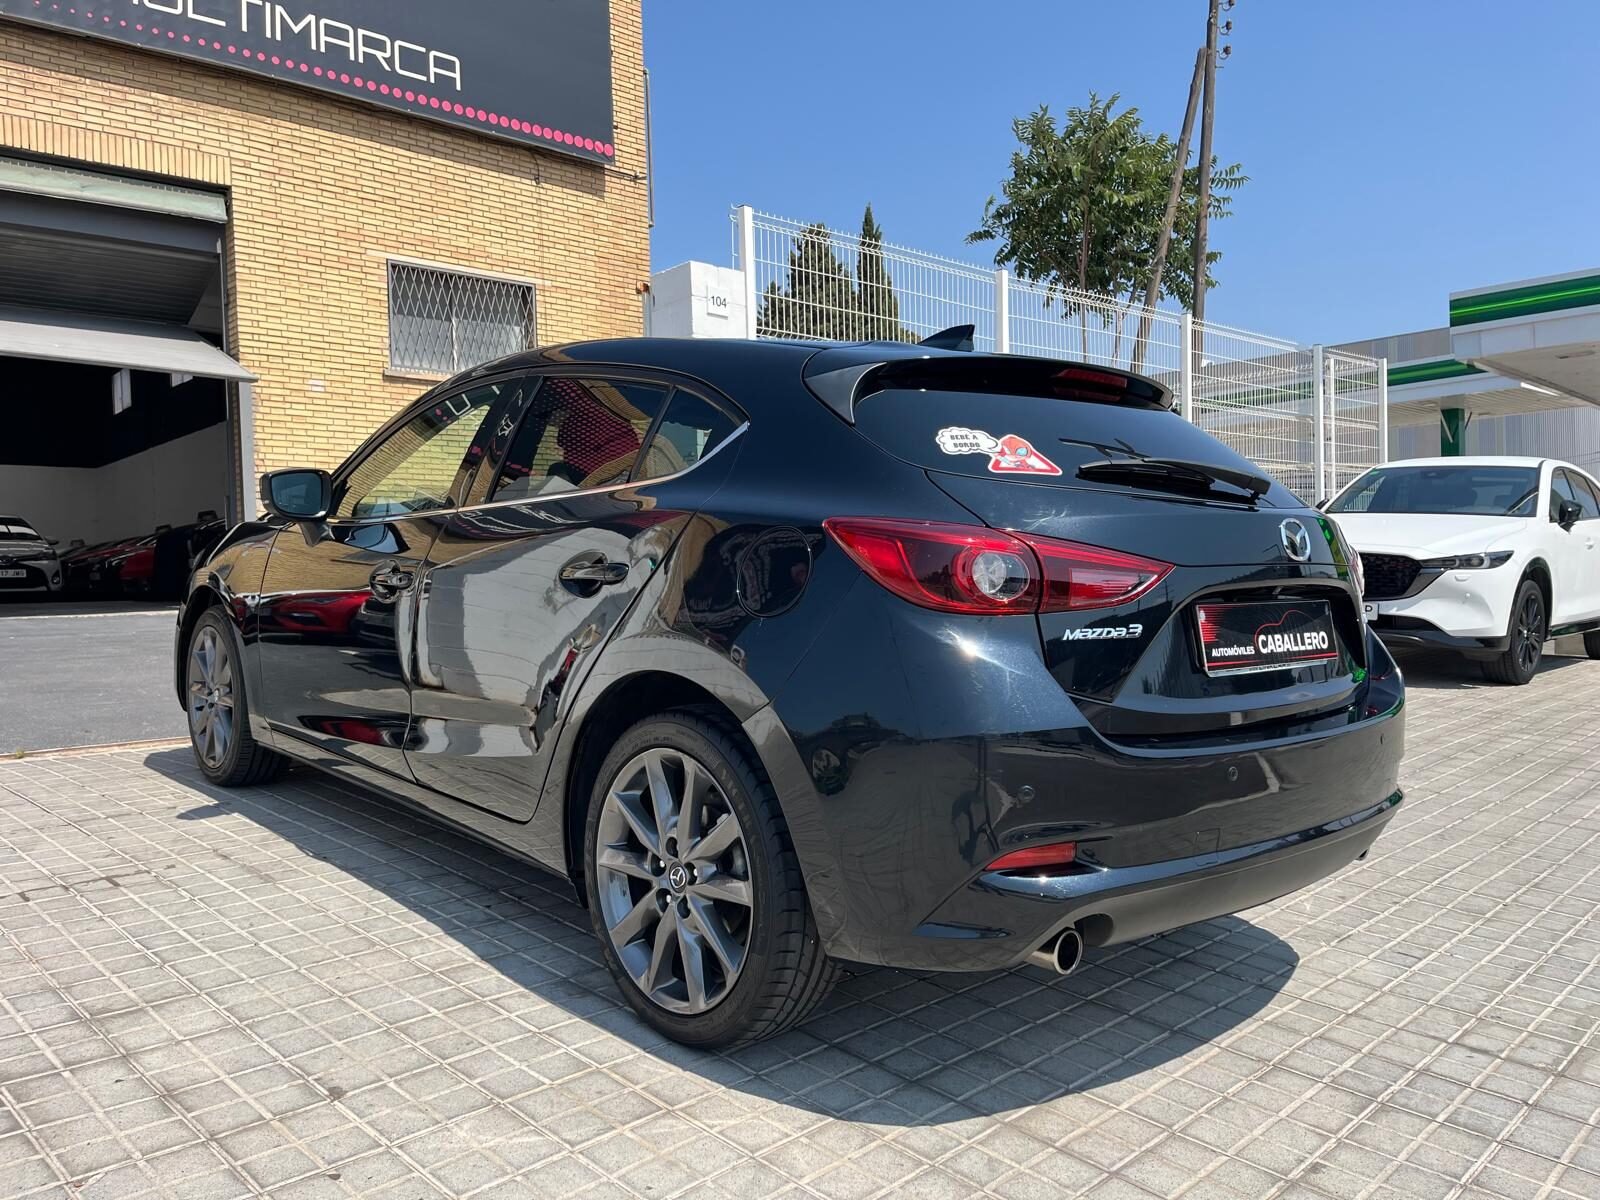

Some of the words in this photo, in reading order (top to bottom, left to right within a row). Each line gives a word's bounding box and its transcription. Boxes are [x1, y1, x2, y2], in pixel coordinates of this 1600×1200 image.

[132, 0, 461, 91] LTIMARCA
[711, 295, 727, 308] 104
[1211, 644, 1256, 657] AUTOMÓVILES
[1258, 631, 1329, 654] CABALLERO
